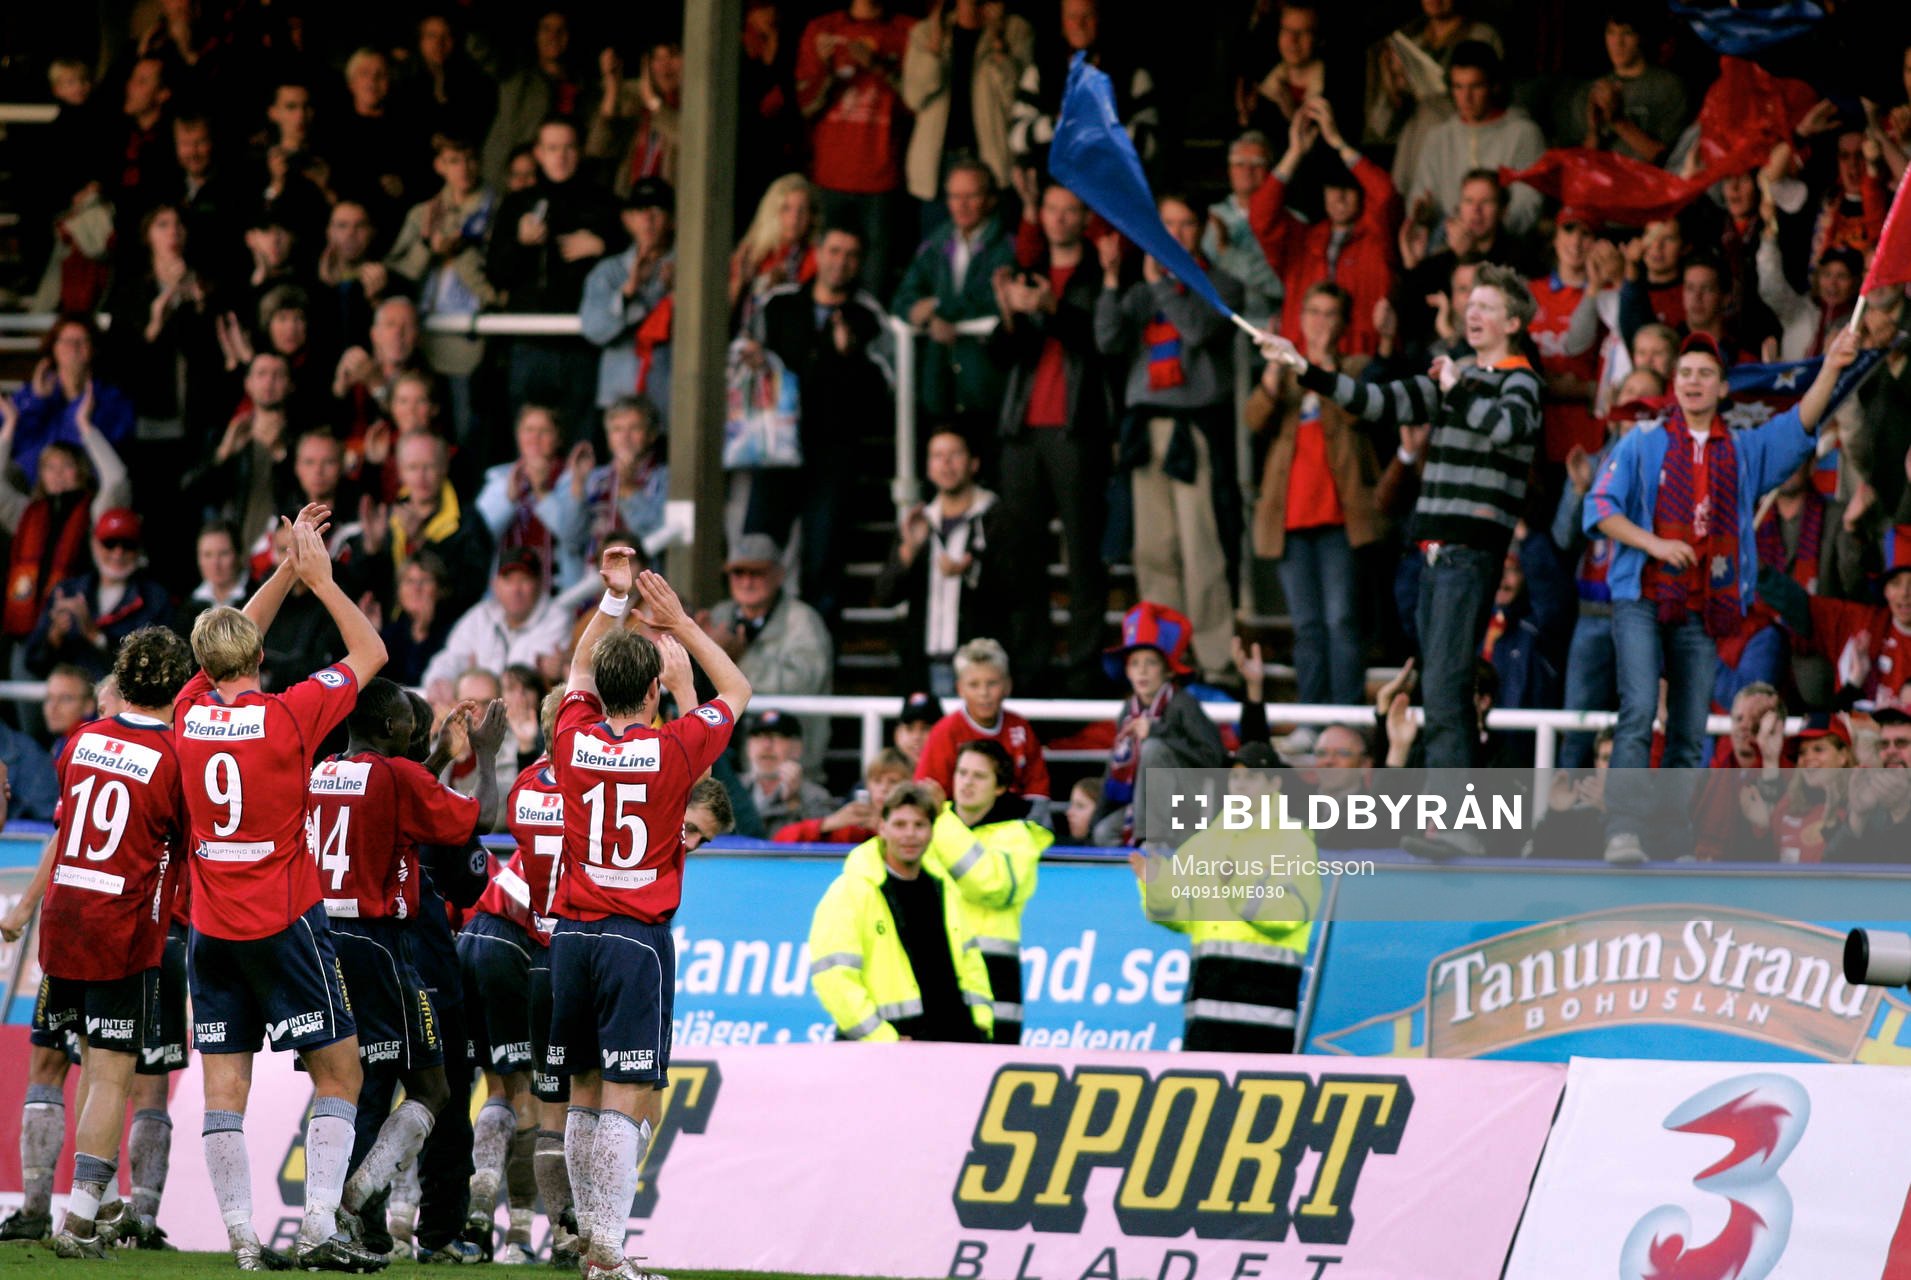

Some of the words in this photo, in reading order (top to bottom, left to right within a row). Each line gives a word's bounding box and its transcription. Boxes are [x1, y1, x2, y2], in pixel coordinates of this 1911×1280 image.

[311, 779, 335, 790] ena
[204, 752, 243, 838] 9
[64, 774, 130, 861] 19
[582, 781, 648, 868] 15
[471, 854, 486, 871] 13
[534, 834, 563, 916] 7
[674, 925, 813, 998] tanu
[1020, 929, 1190, 1006] nd.se
[1436, 928, 1663, 1026] Tanum
[1524, 987, 1772, 1032] BOHUSLÄN
[101, 1019, 134, 1029] INTER
[288, 1010, 323, 1028] INTER
[291, 1019, 324, 1037] SPORT
[101, 1029, 134, 1039] SPORT
[367, 1040, 400, 1055] INTER
[506, 1041, 531, 1053] INTE
[619, 1049, 653, 1061] INTER
[368, 1050, 400, 1064] SPORT
[620, 1059, 654, 1071] SPORT
[954, 1064, 1406, 1232] SPORT
[1619, 1072, 1812, 1280] 3
